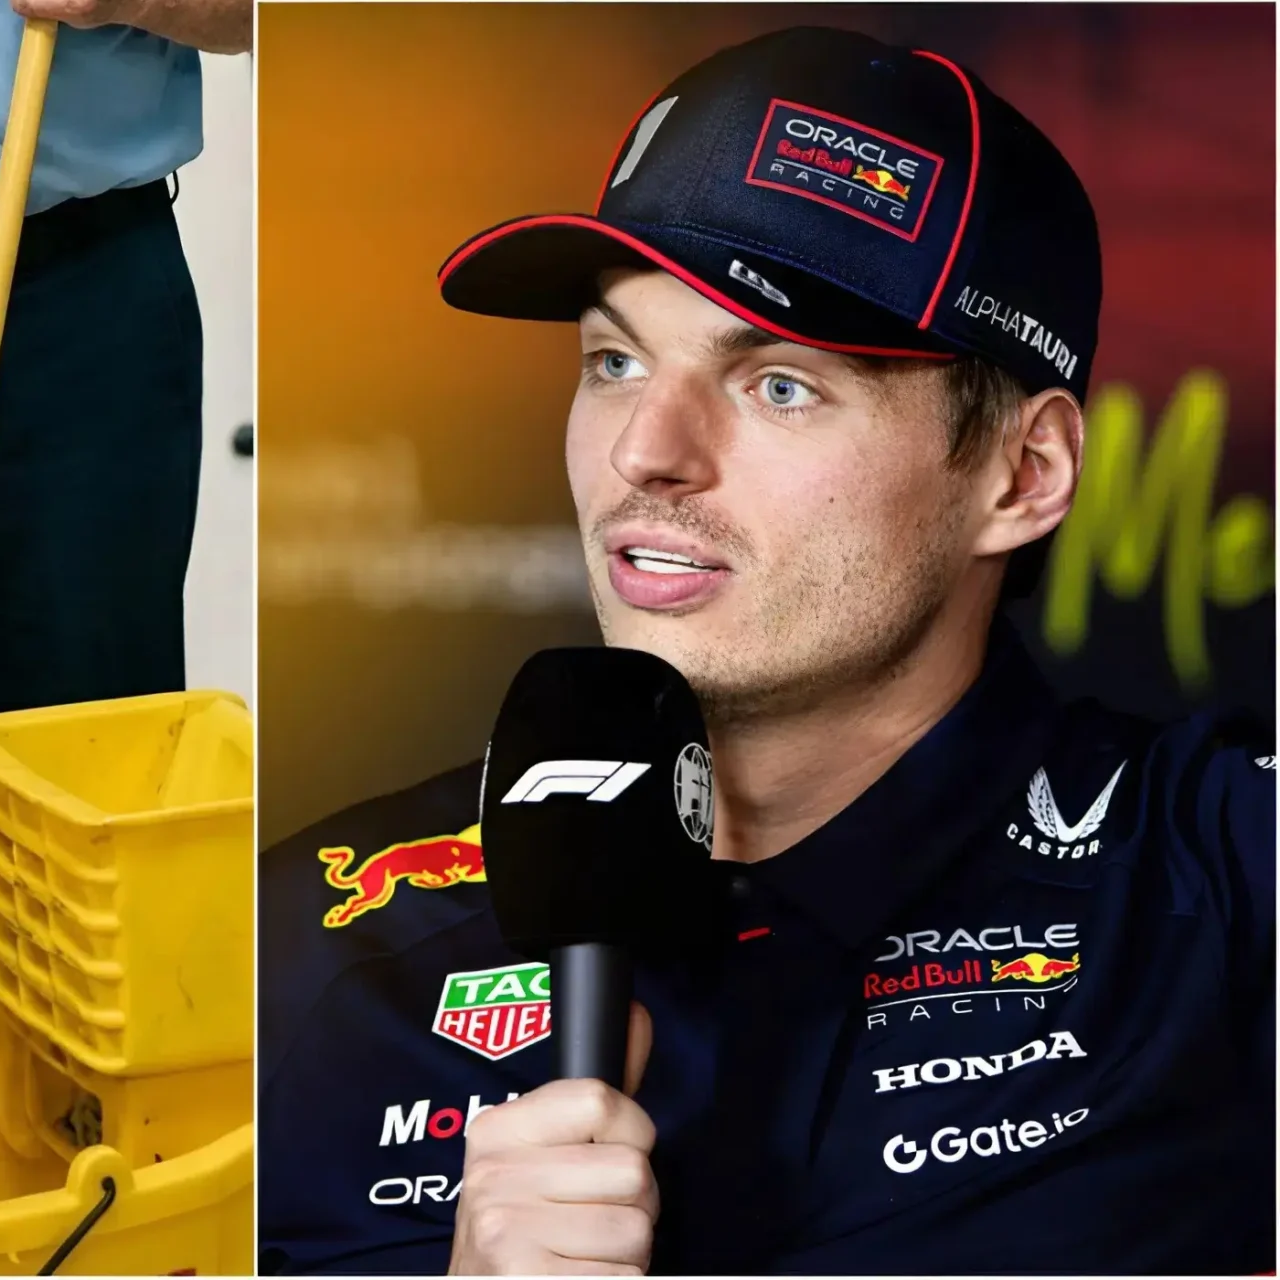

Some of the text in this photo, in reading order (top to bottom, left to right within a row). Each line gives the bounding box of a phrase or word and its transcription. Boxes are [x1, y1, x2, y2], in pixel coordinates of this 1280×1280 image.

[785, 119, 919, 180] ORACLE
[770, 162, 906, 220] RACING
[954, 285, 1078, 380] ALPHATAURI
[500, 760, 652, 803] F1
[1006, 822, 1104, 859] CASTOR
[867, 995, 1046, 1031] RACIN
[872, 1030, 1088, 1093] HONDA
[930, 1107, 1089, 1163] Gate.io
